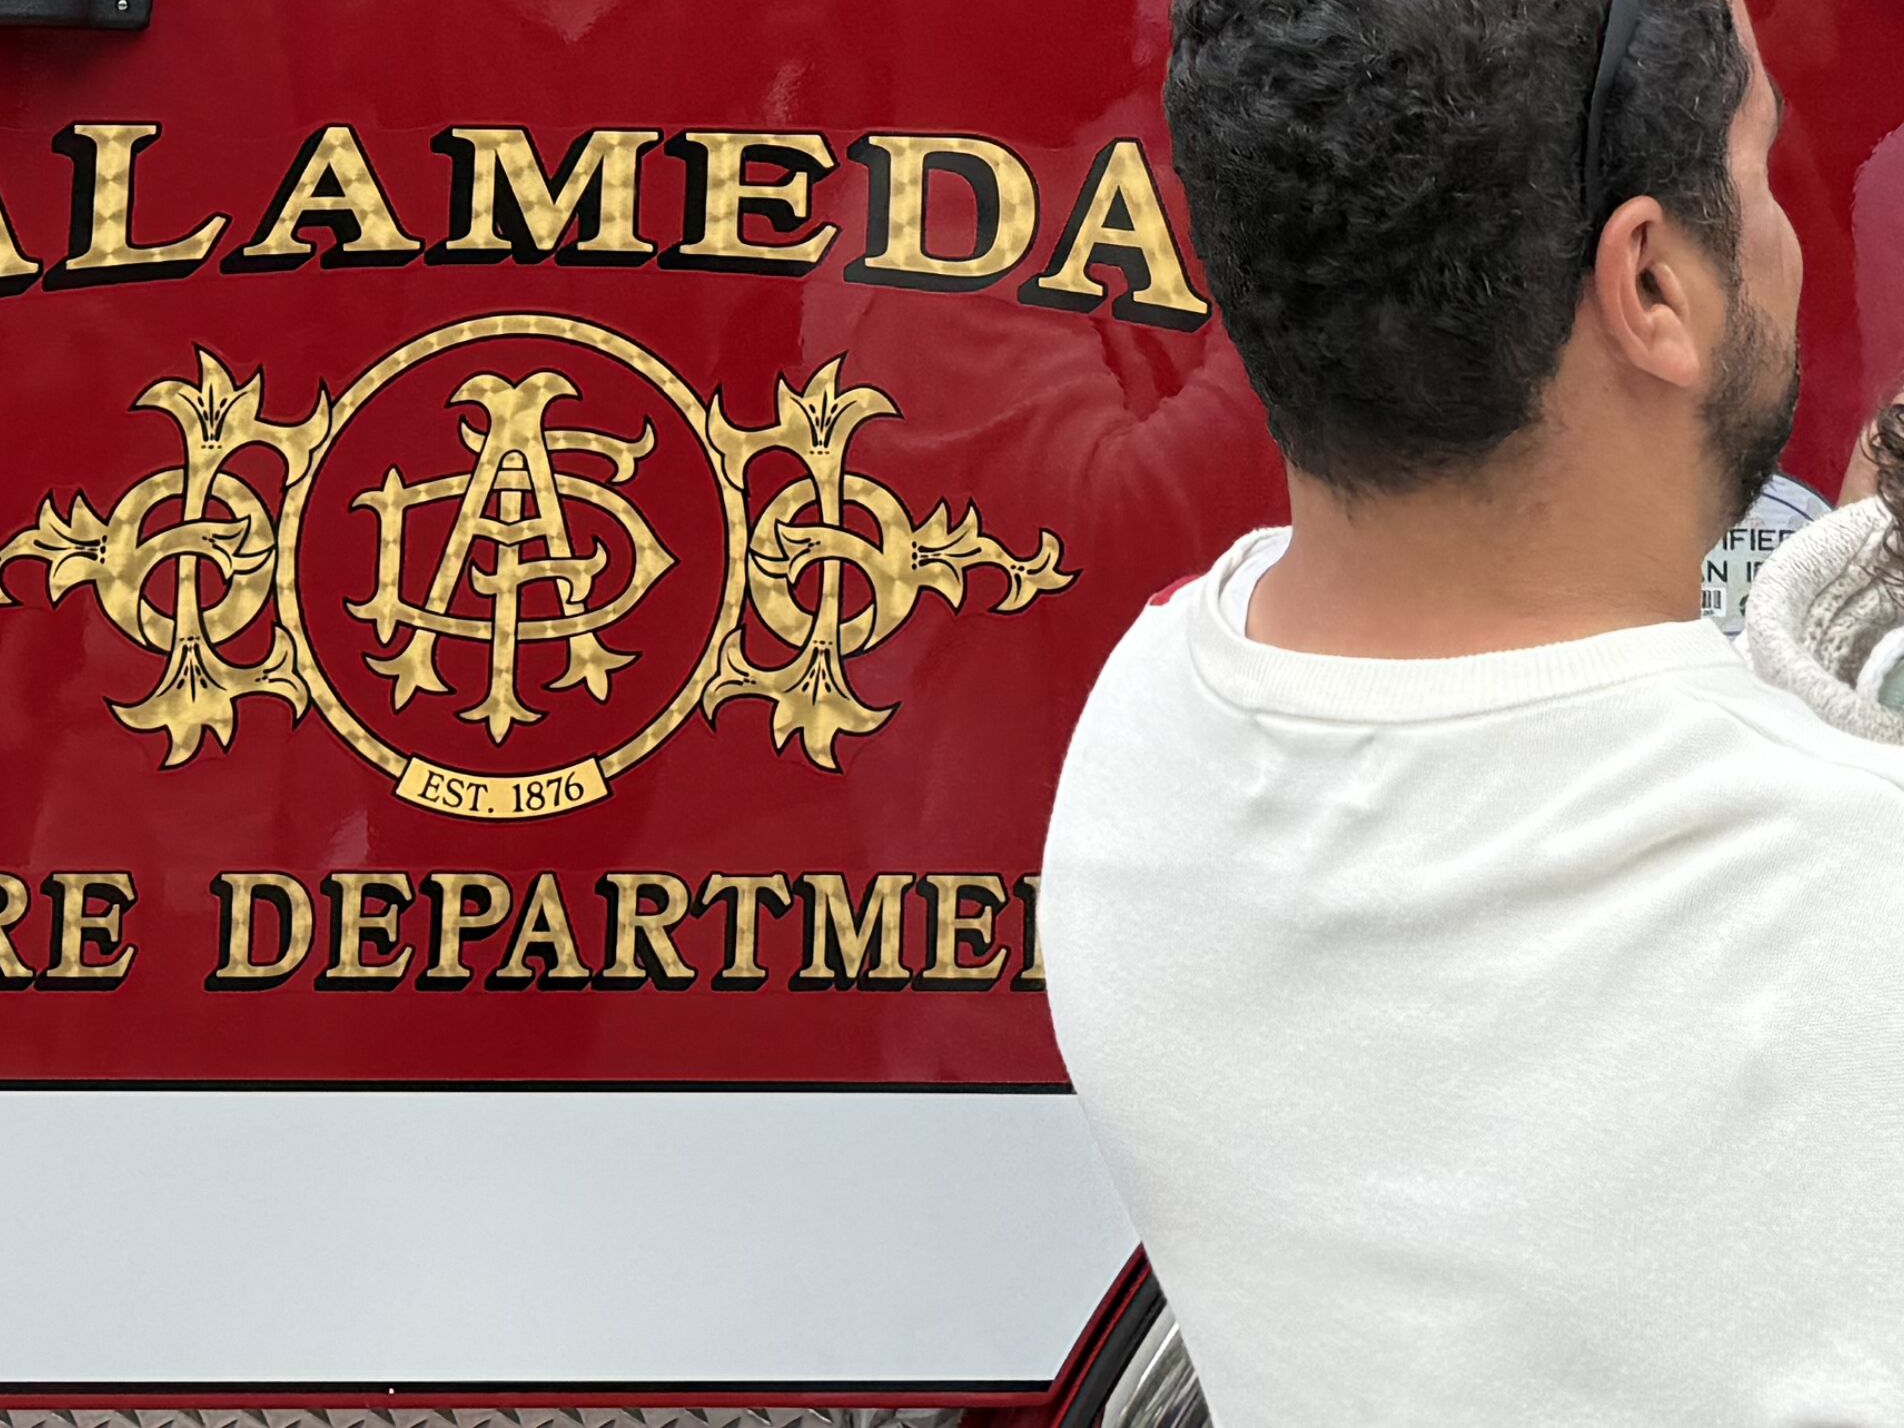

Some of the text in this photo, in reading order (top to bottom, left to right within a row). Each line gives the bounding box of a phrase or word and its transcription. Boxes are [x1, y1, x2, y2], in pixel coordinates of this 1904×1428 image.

[417, 769, 585, 815] EST. 1876
[202, 870, 1052, 992] DEPARTME
